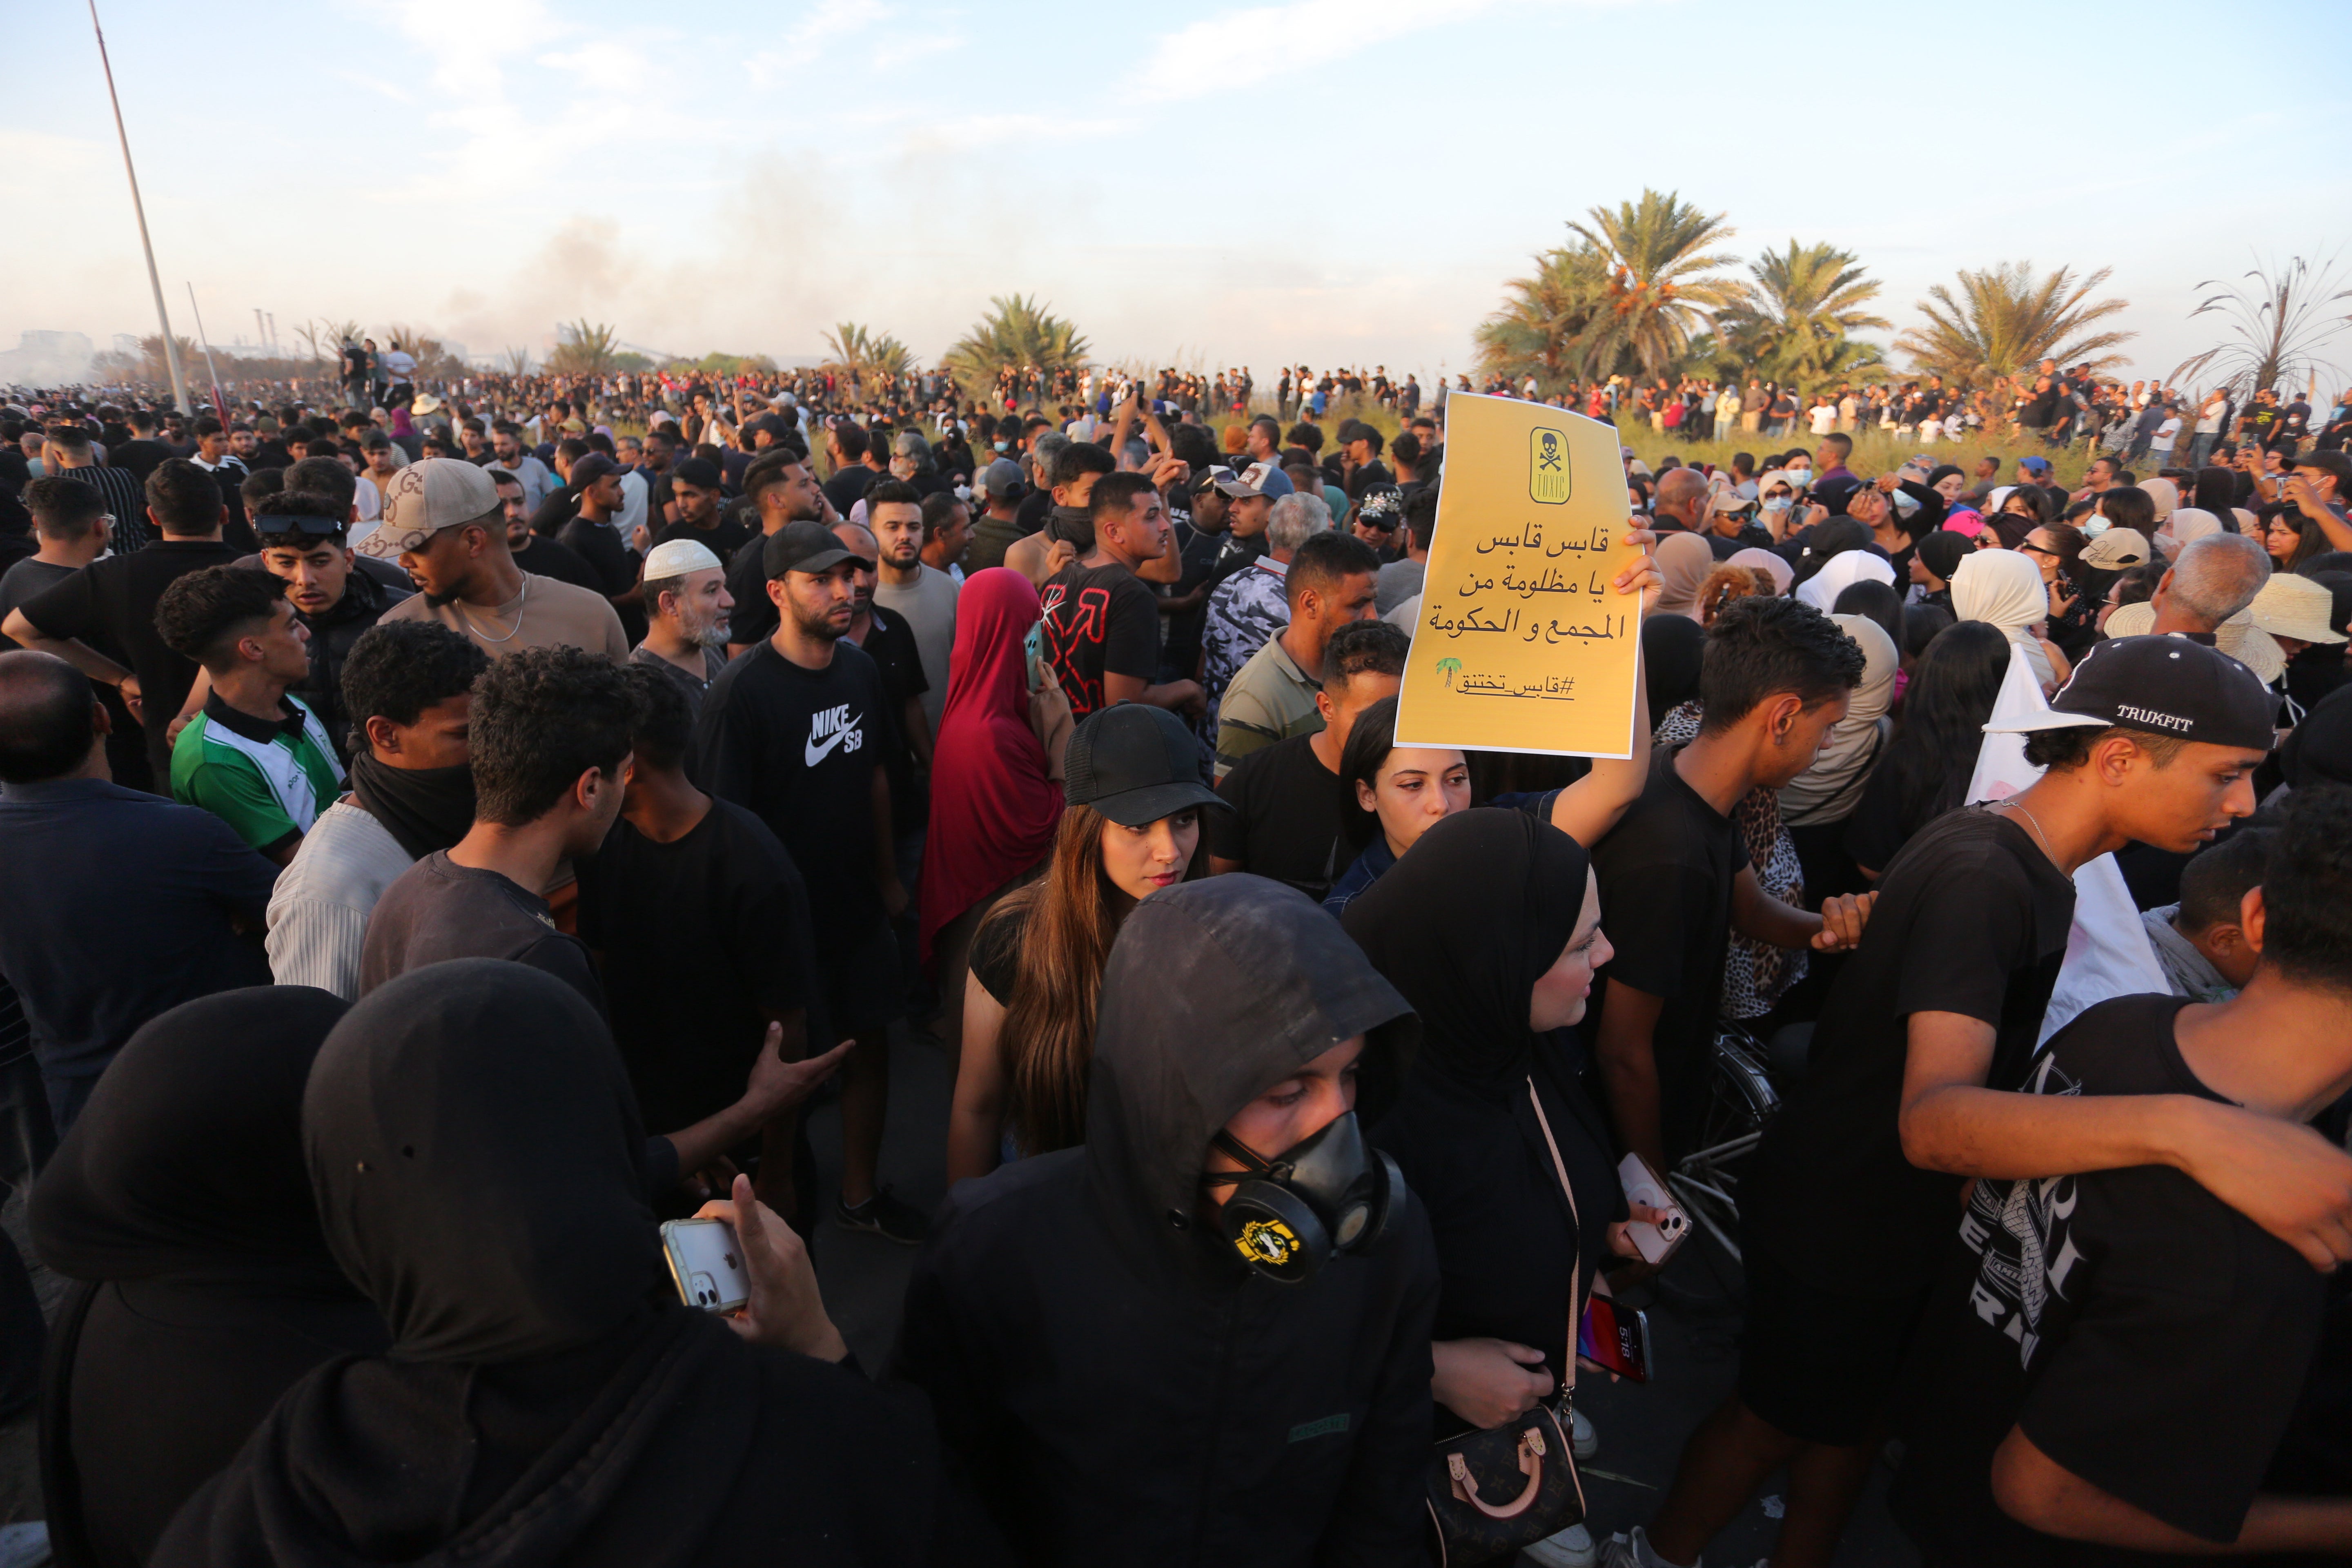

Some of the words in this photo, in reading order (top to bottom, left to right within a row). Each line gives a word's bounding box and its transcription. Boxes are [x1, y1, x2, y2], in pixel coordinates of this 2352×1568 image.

[1537, 474, 1564, 499] TOXIC
[1476, 522, 1543, 556] قابس
[1546, 526, 1608, 559] قابس
[1459, 573, 1494, 597] من
[1502, 565, 1577, 599] مظلومة
[1589, 570, 1605, 604] يا
[1429, 605, 1520, 639] الحكومة
[1523, 623, 1539, 642] و
[1546, 614, 1625, 646] المجمع
[1456, 674, 1575, 697] #قابس_تختنق
[812, 703, 849, 740] NIKE
[2117, 705, 2193, 732] TRUKFIT
[844, 729, 862, 753] SB
[1619, 1326, 1630, 1358] 5:18
